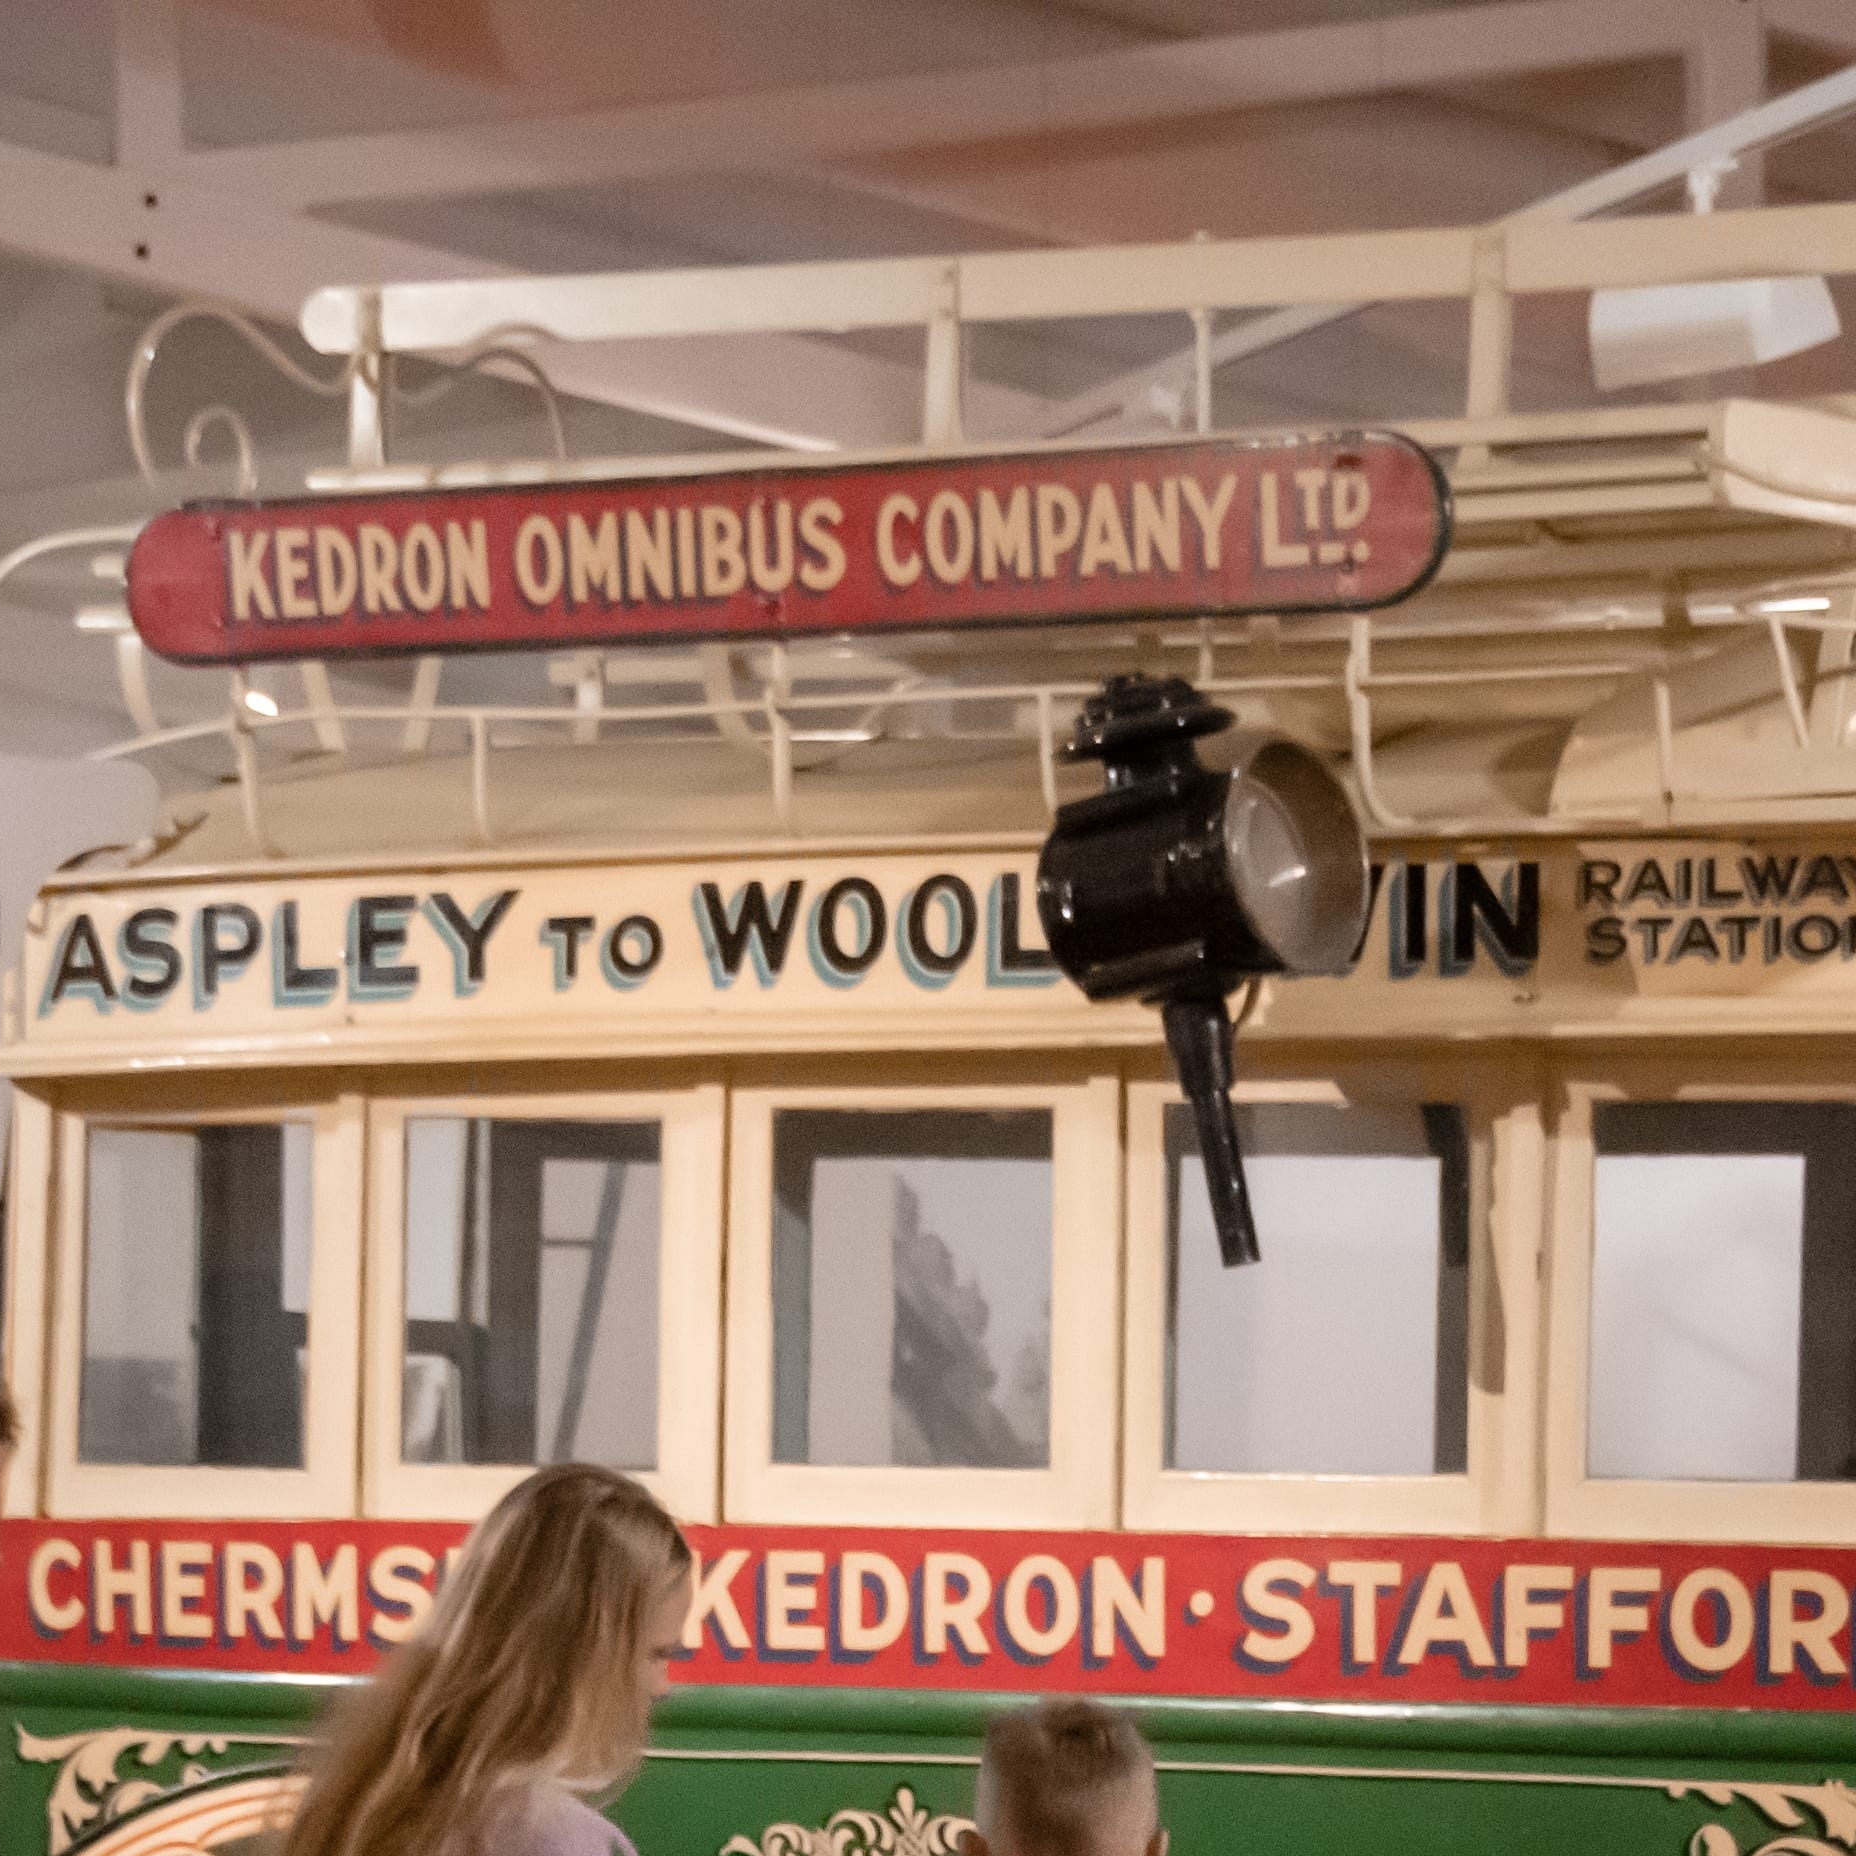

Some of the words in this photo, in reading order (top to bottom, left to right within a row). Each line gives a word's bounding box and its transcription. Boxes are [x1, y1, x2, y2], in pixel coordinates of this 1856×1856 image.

[226, 518, 491, 622] KEDRON
[514, 495, 846, 606] OMNIBUS
[876, 473, 1238, 584] COMPANY
[42, 886, 522, 1008] ASPLEY
[546, 913, 665, 984] TO
[28, 1538, 466, 1646] CHERMS
[681, 1549, 1166, 1662] KEDRON
